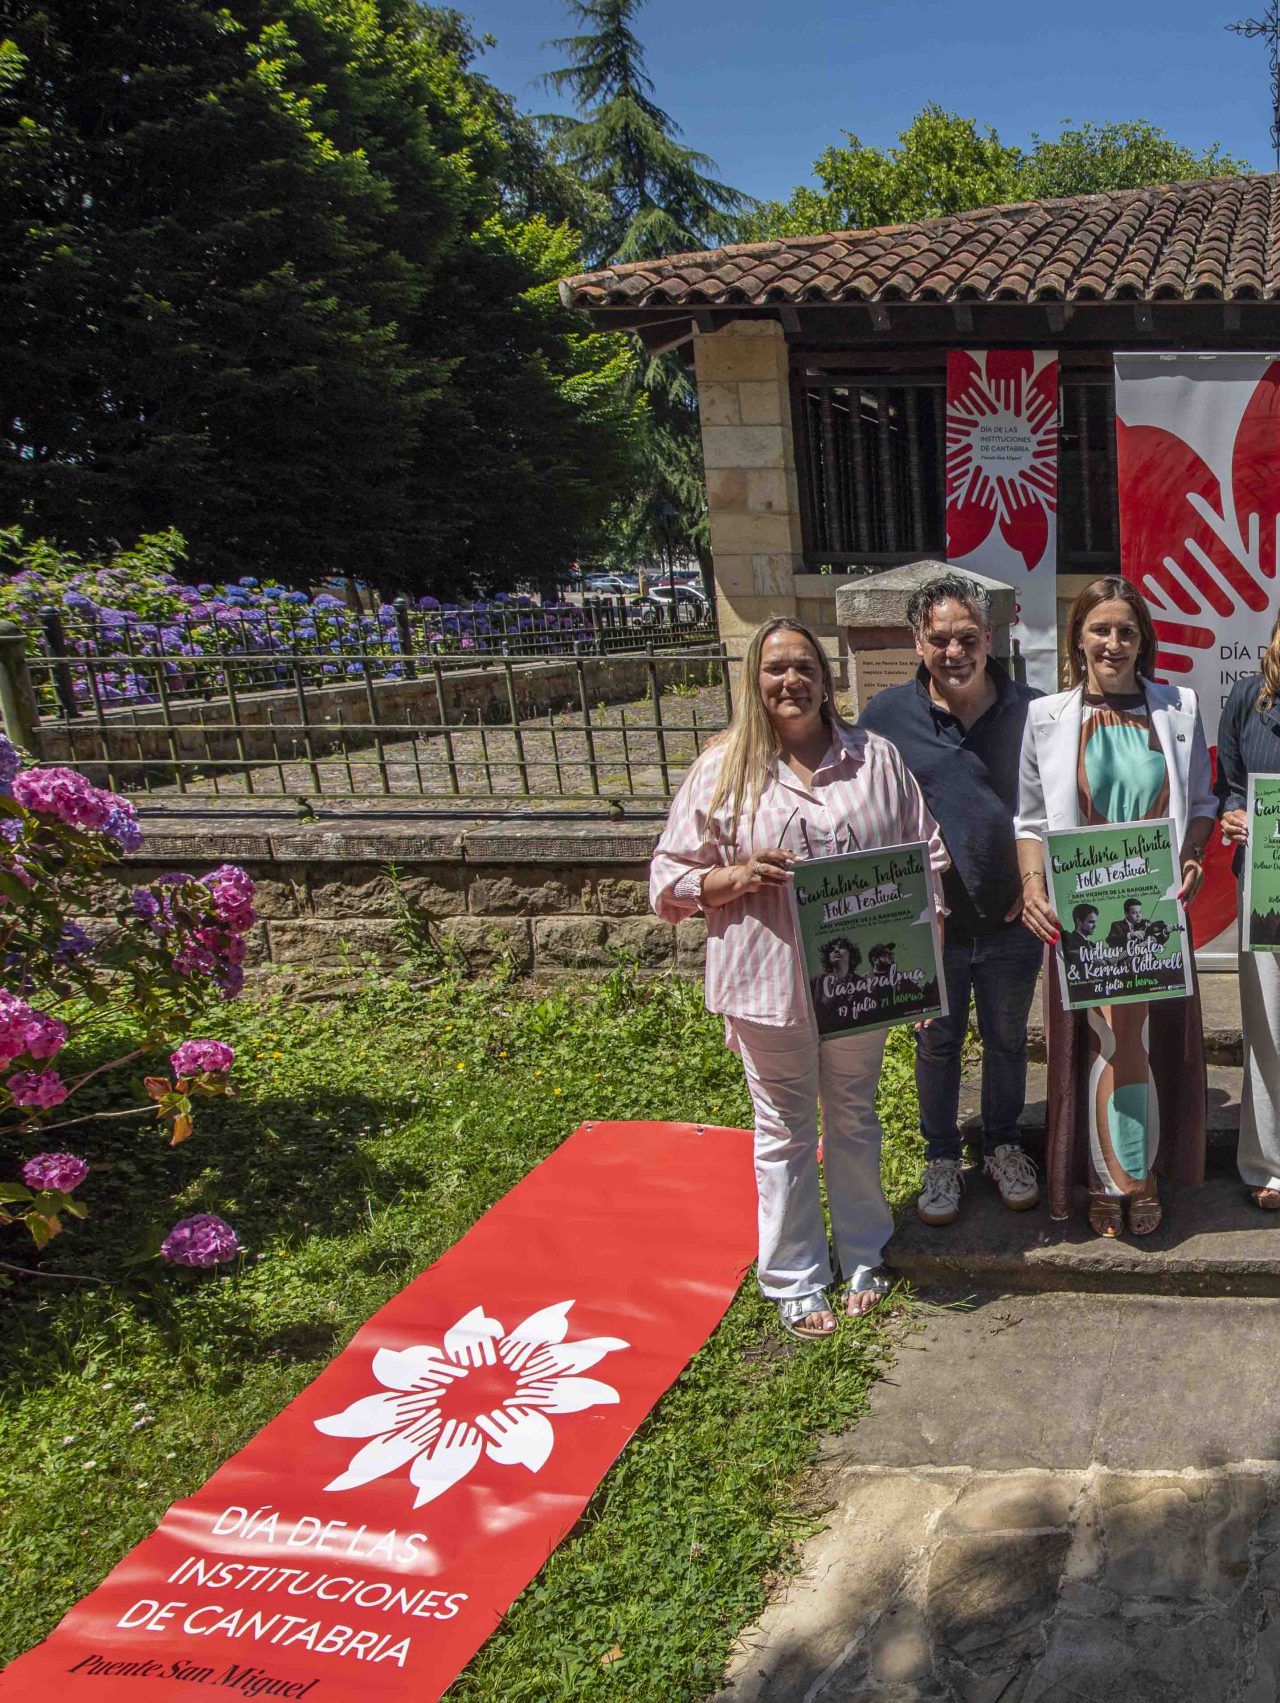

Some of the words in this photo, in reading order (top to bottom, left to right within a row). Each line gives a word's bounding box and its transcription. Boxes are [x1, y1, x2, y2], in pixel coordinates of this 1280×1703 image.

[980, 425, 992, 433] DÍA
[1220, 641, 1252, 660] DÍA
[1257, 645, 1268, 660] D
[1122, 829, 1171, 859] Infinita
[872, 854, 925, 885] Infinita
[1075, 869, 1103, 889] Folk
[1104, 857, 1152, 882] Festival
[822, 898, 854, 919] Folk
[854, 883, 904, 911] Festival
[1085, 890, 1109, 898] VICENTE
[1126, 885, 1158, 894] BARQUERA
[1079, 940, 1123, 962] Arthur
[1127, 935, 1165, 957] Coates
[823, 964, 925, 998] Casapalma
[1067, 964, 1080, 980] &
[1084, 963, 1130, 980] Kerran
[1132, 951, 1183, 974] Cotterell
[1094, 983, 1103, 993] 26
[1104, 978, 1124, 995] julio
[1135, 974, 1158, 987] horas
[838, 1005, 848, 1017] 19
[852, 997, 877, 1020] julio
[893, 987, 923, 1005] horas
[211, 1504, 279, 1545] DÍA
[287, 1516, 340, 1551] DE
[346, 1523, 428, 1565] LAS
[167, 1555, 470, 1621] INSTITUCIONES
[116, 1599, 184, 1632] DE
[183, 1605, 412, 1668] CANTABRIA
[68, 1654, 163, 1681] Puente
[158, 1659, 217, 1683] San
[217, 1662, 322, 1700] Miguel
